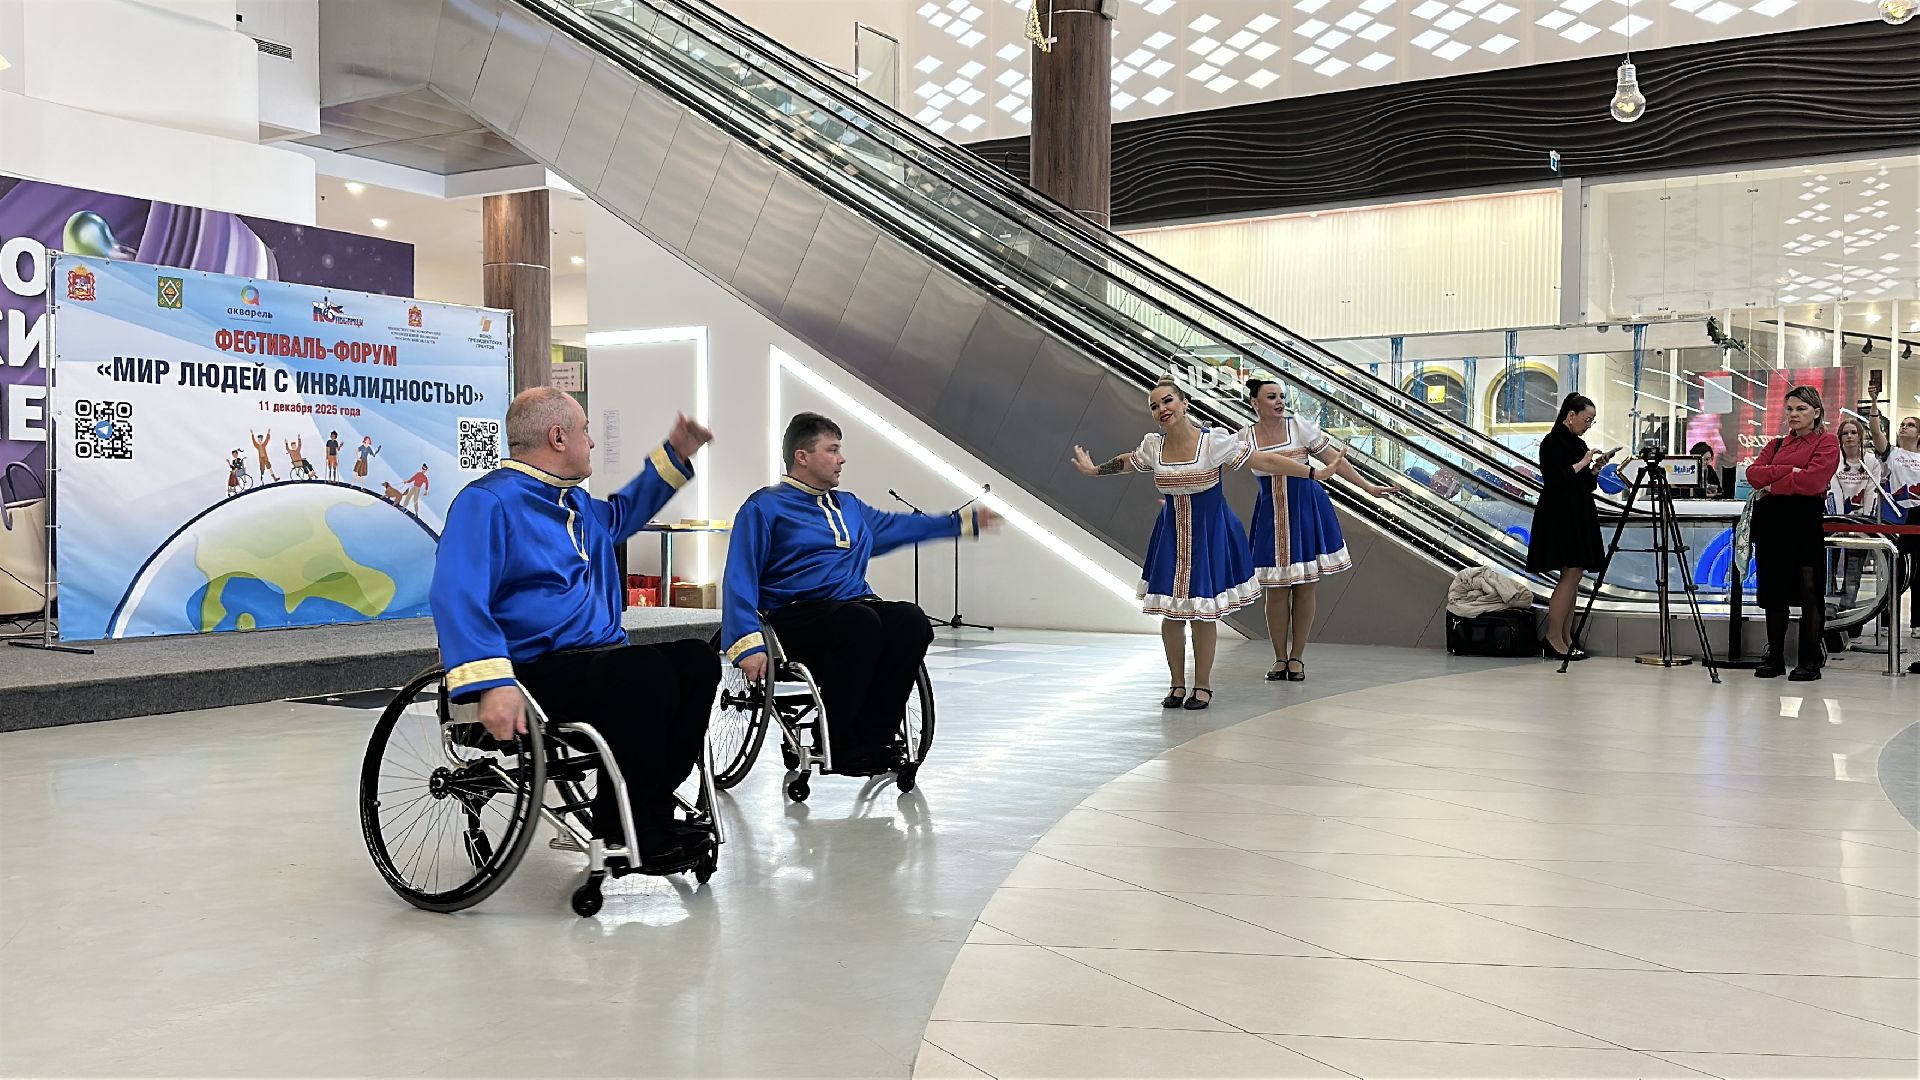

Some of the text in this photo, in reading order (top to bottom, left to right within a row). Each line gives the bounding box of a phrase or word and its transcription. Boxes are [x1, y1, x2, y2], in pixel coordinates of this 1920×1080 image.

[227, 307, 273, 319] акварель
[0, 309, 56, 369] И
[215, 328, 398, 367] ФЕСТИВАЛЬ-ФОРУМ
[97, 356, 484, 405] «МИР ЛЮДЕЙ С ИНВАЛИДНОСТЬЮ»
[258, 400, 361, 417] 11 декабря 2025 года
